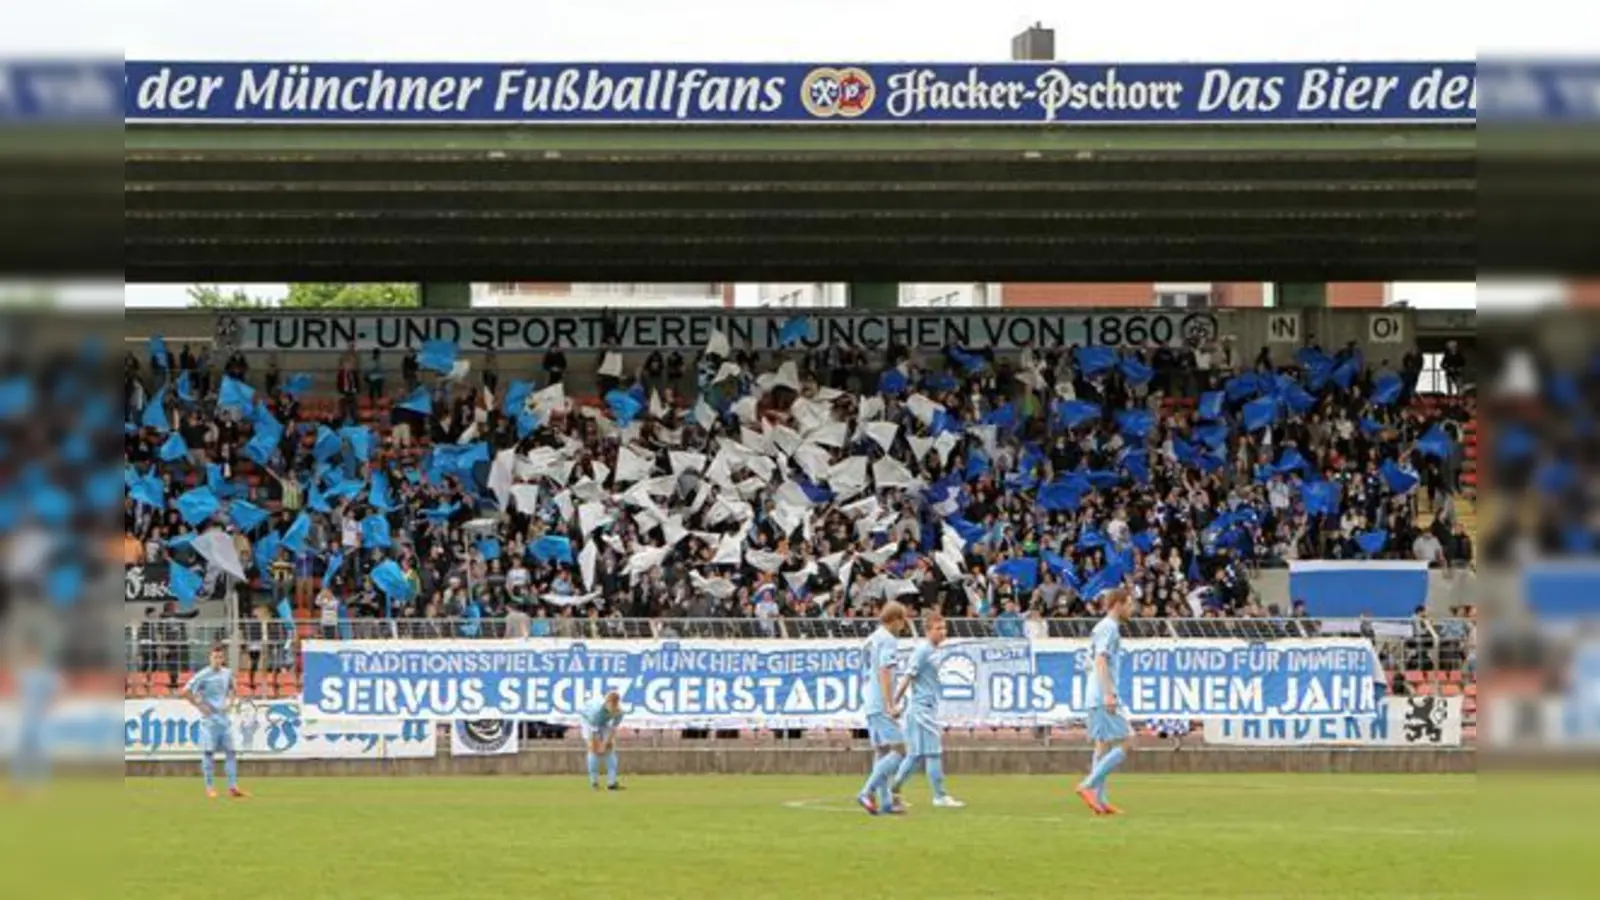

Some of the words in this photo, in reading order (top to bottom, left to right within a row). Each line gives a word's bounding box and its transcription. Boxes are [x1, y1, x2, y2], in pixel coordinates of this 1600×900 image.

[137, 67, 224, 110] der
[234, 65, 484, 111] Münchner
[494, 67, 785, 118] Fußballfans
[886, 67, 1182, 121] Hacker-Pschorr
[1198, 69, 1284, 111] Das
[1298, 67, 1399, 111] Bier
[250, 318, 366, 348] TURN-
[376, 318, 461, 348] UND
[983, 315, 1067, 347] VON
[1081, 314, 1173, 346] 1860
[1132, 652, 1169, 673] 1911
[1175, 652, 1227, 672] UND
[1232, 645, 1280, 672] FÜR
[1287, 650, 1368, 672] IMMER!
[319, 677, 485, 714] SERVUS
[992, 676, 1054, 711] BIS
[1131, 677, 1263, 712] EINEM
